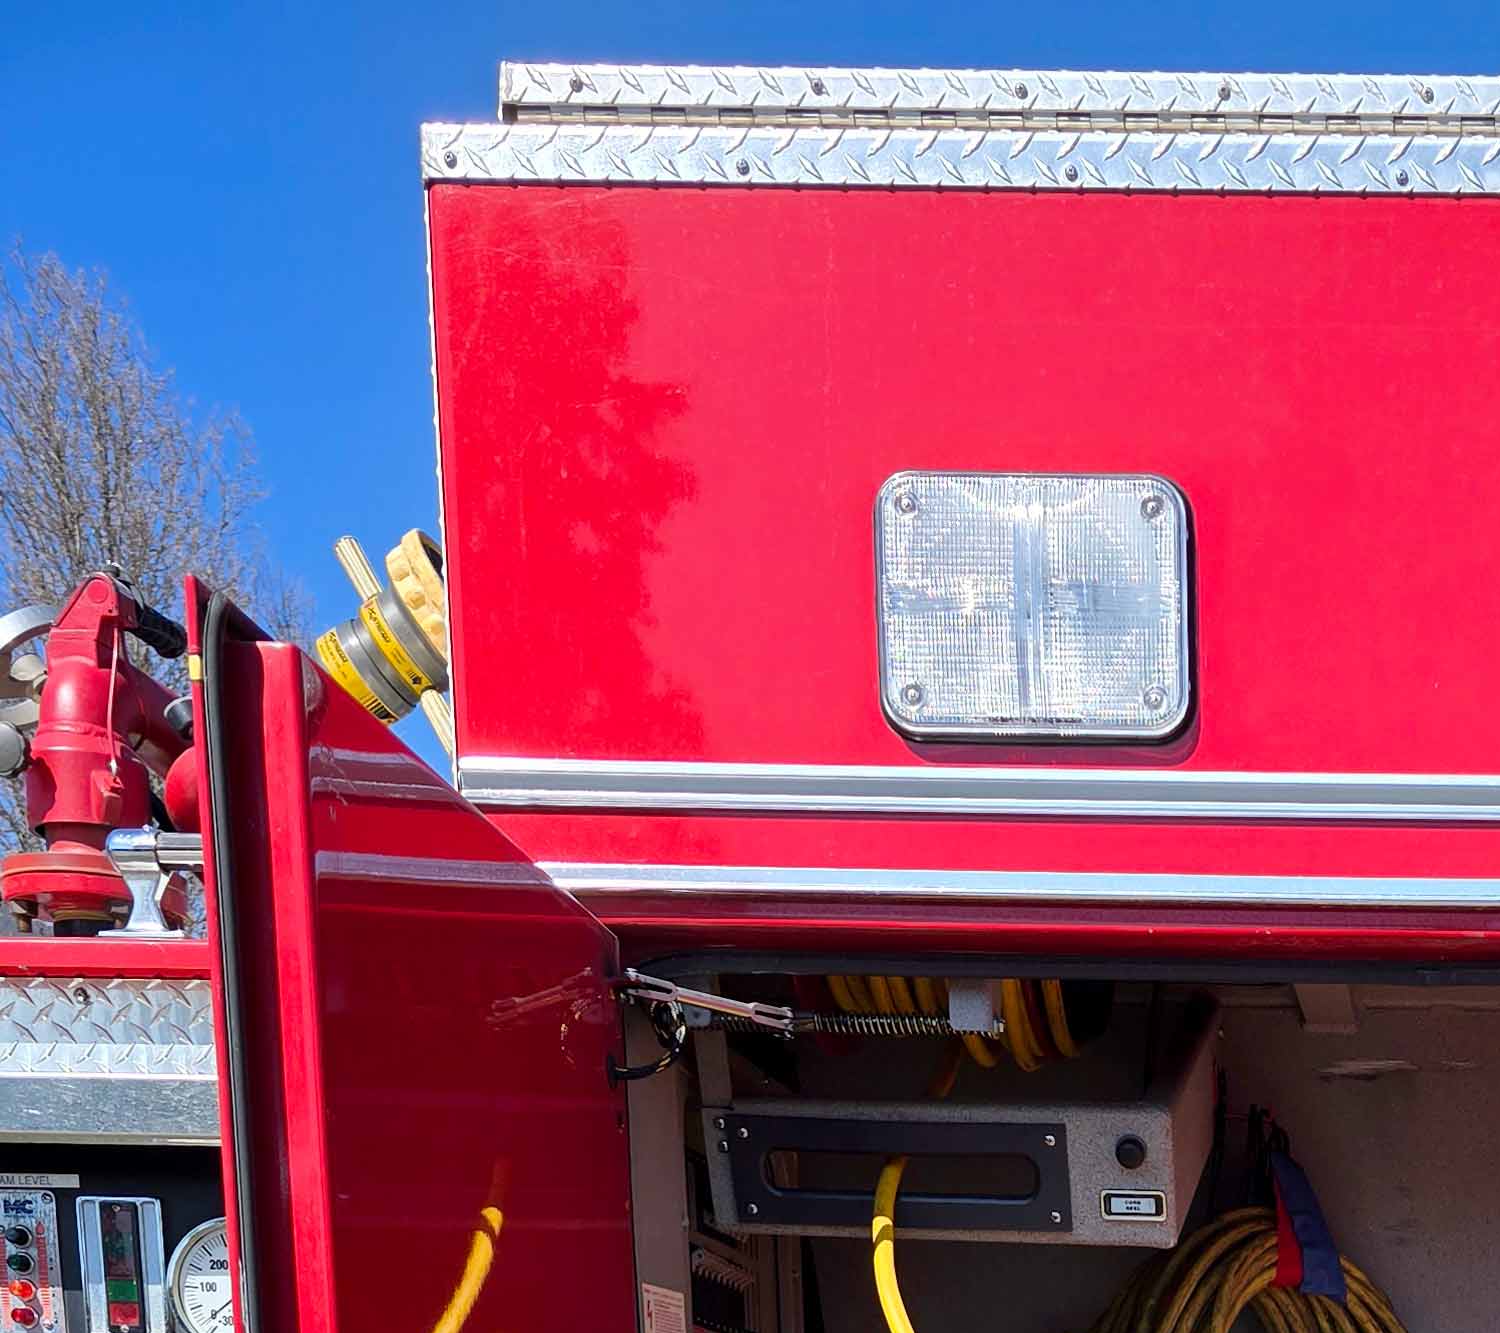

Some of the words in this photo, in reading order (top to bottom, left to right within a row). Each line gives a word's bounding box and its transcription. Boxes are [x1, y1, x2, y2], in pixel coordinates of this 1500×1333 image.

[0, 1175, 14, 1185] AM
[18, 1175, 52, 1186] LEVEL
[210, 1260, 229, 1270] 200
[200, 1282, 217, 1293] 100
